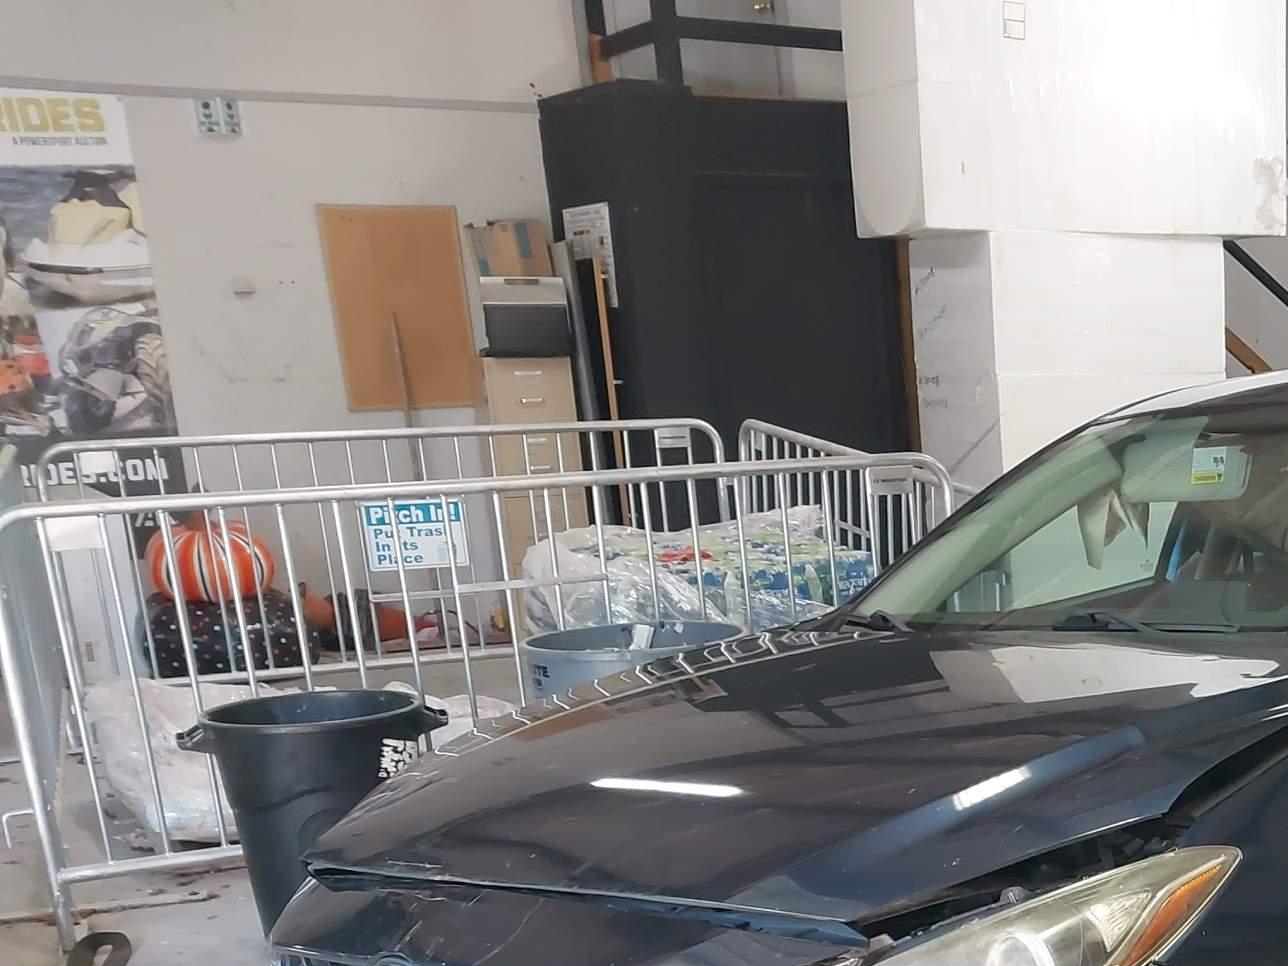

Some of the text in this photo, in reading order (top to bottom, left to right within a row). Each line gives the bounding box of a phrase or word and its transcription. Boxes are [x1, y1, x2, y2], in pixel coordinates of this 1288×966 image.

[369, 505, 424, 525] Pich
[373, 526, 449, 539] Pu Tras
[375, 540, 418, 553] In ts
